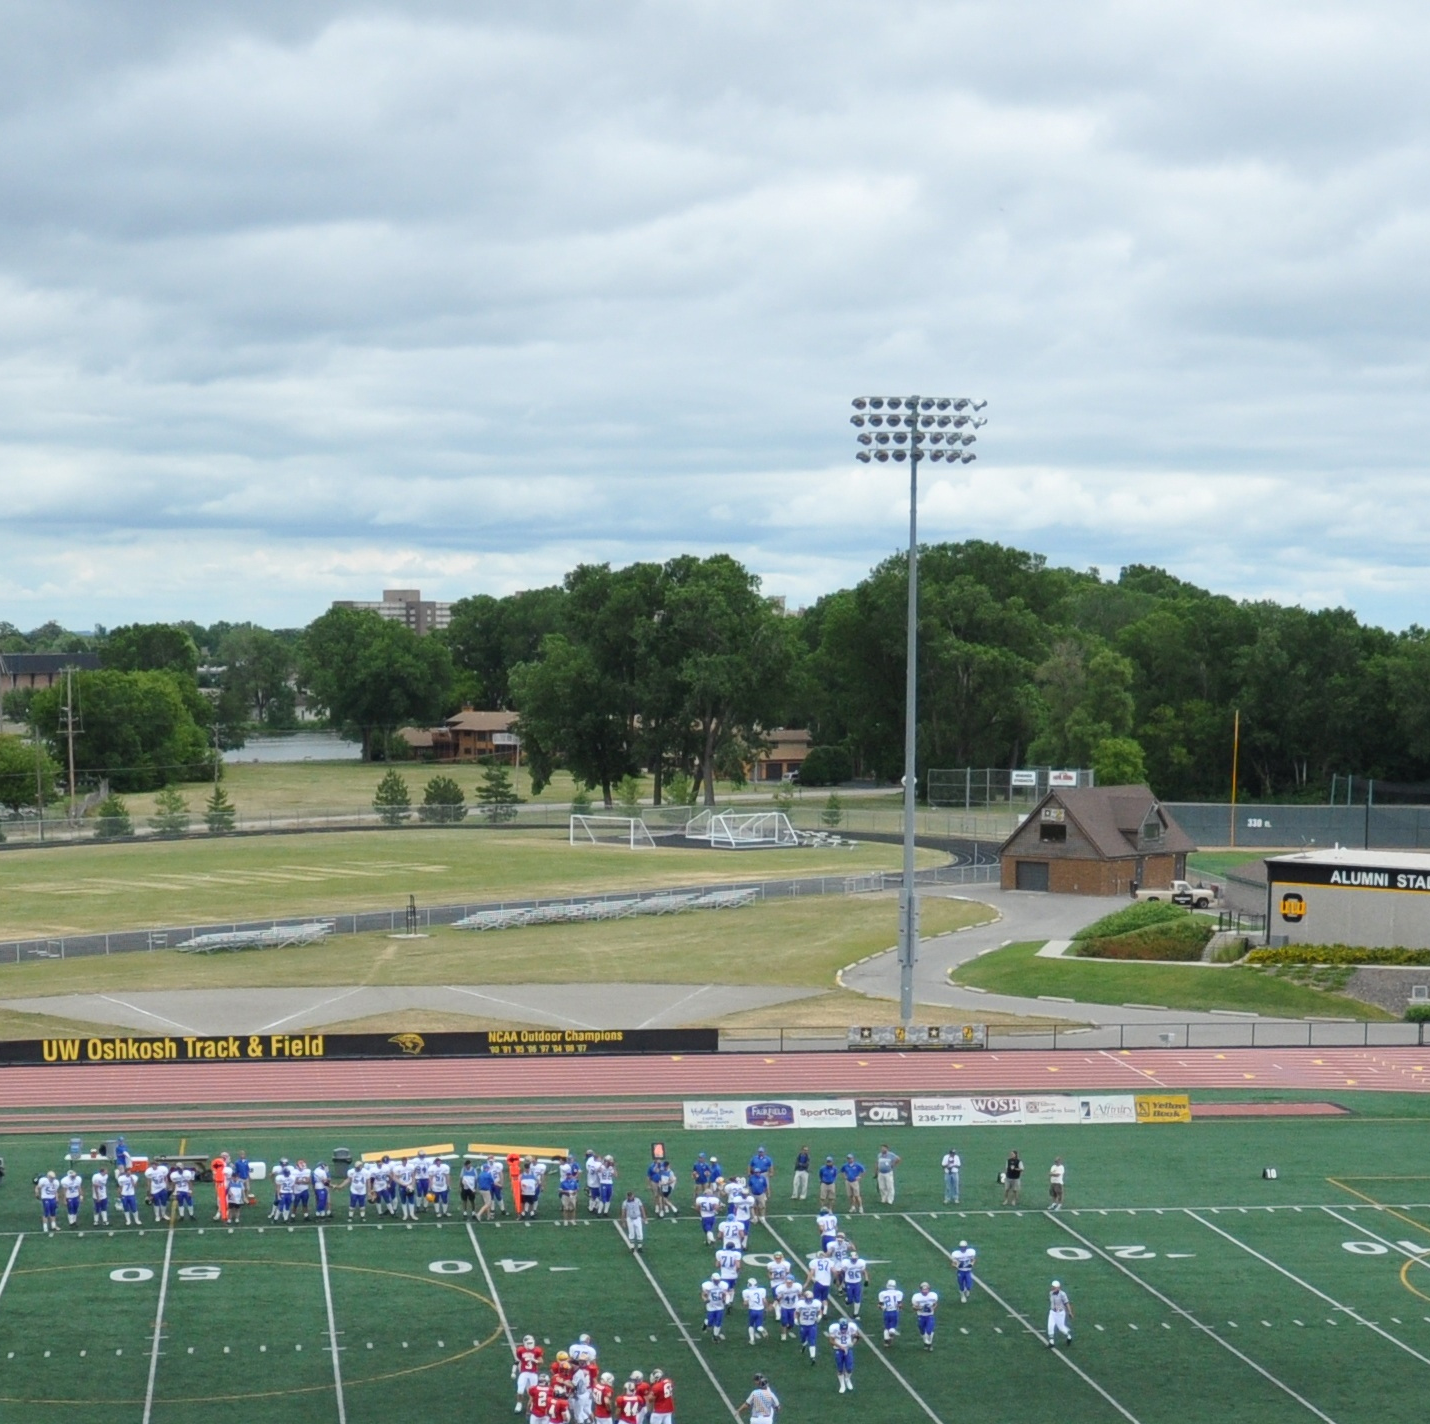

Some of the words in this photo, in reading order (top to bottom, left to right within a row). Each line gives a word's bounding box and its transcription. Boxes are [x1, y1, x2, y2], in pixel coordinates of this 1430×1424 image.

[1330, 870, 1389, 888] ALUMNI
[488, 1031, 518, 1043] NCAA
[521, 1031, 562, 1042] Outdoor
[565, 1030, 623, 1044] Champions
[42, 1039, 80, 1062] UW
[87, 1037, 177, 1060] Oshkosh
[183, 1036, 241, 1059] Track
[247, 1036, 263, 1057] &
[271, 1034, 324, 1057] Field
[972, 1098, 1021, 1112] WOSH
[1152, 1101, 1187, 1110] Yellow
[800, 1108, 852, 1118] SportClips
[917, 1114, 962, 1122] 236-7777
[1153, 1110, 1180, 1118] Book
[1266, 1168, 1277, 1178] 10
[725, 1225, 738, 1237] 72
[721, 1255, 735, 1268] 71
[753, 1292, 761, 1305] 3
[883, 1295, 897, 1307] 21
[537, 1391, 548, 1408] 2
[623, 1400, 639, 1418] 44
